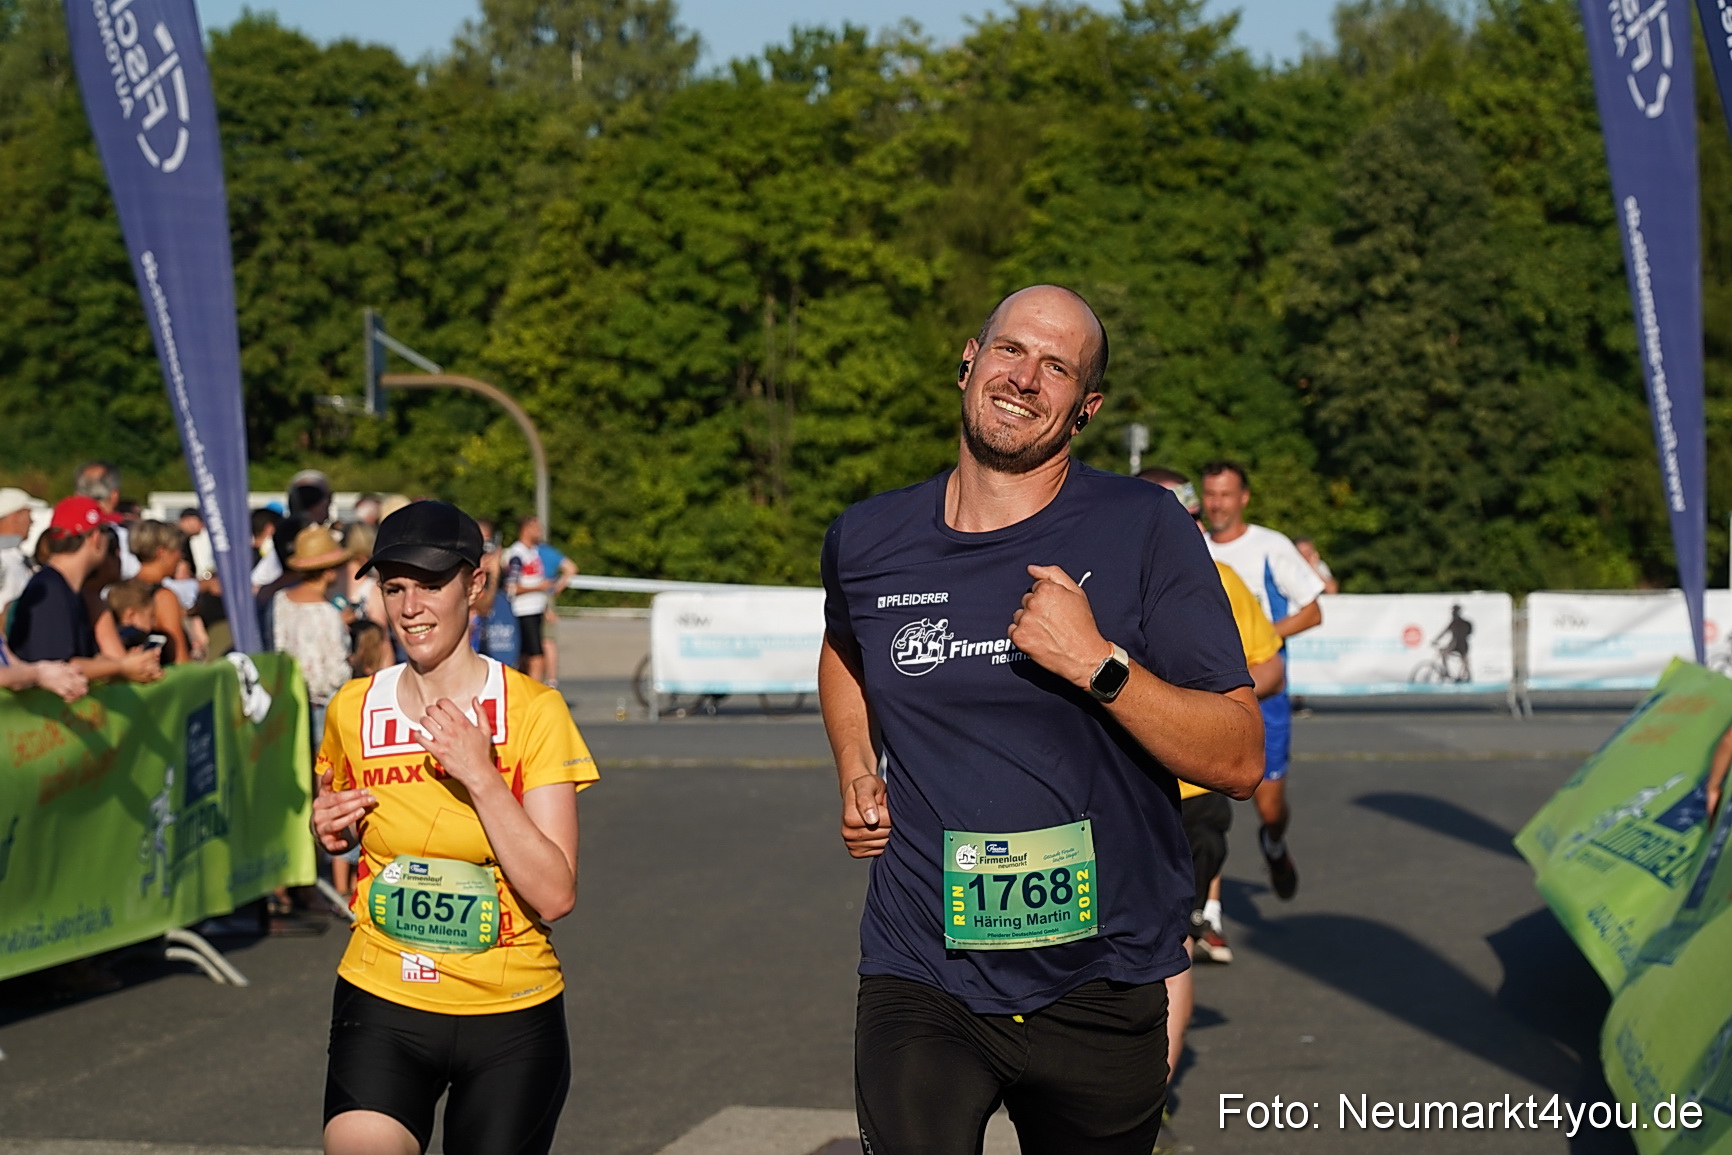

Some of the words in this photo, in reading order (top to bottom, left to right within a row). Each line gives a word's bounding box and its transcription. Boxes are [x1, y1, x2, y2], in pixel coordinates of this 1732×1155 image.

[886, 592, 949, 607] PFLEIDERER
[363, 764, 425, 787] MAX
[980, 852, 1028, 864] Firmenlauf
[998, 861, 1028, 869] neumarkt
[402, 873, 443, 883] Firmenlauf
[968, 867, 1074, 911] 1768
[390, 887, 478, 924] 1657
[952, 886, 966, 926] RUN
[1076, 868, 1091, 922] 2022
[374, 894, 387, 925] RUN
[974, 915, 1022, 930] Häring
[1026, 909, 1071, 926] Martin
[396, 920, 425, 935] Lang
[428, 922, 468, 938] Milena
[479, 900, 493, 943] 2022
